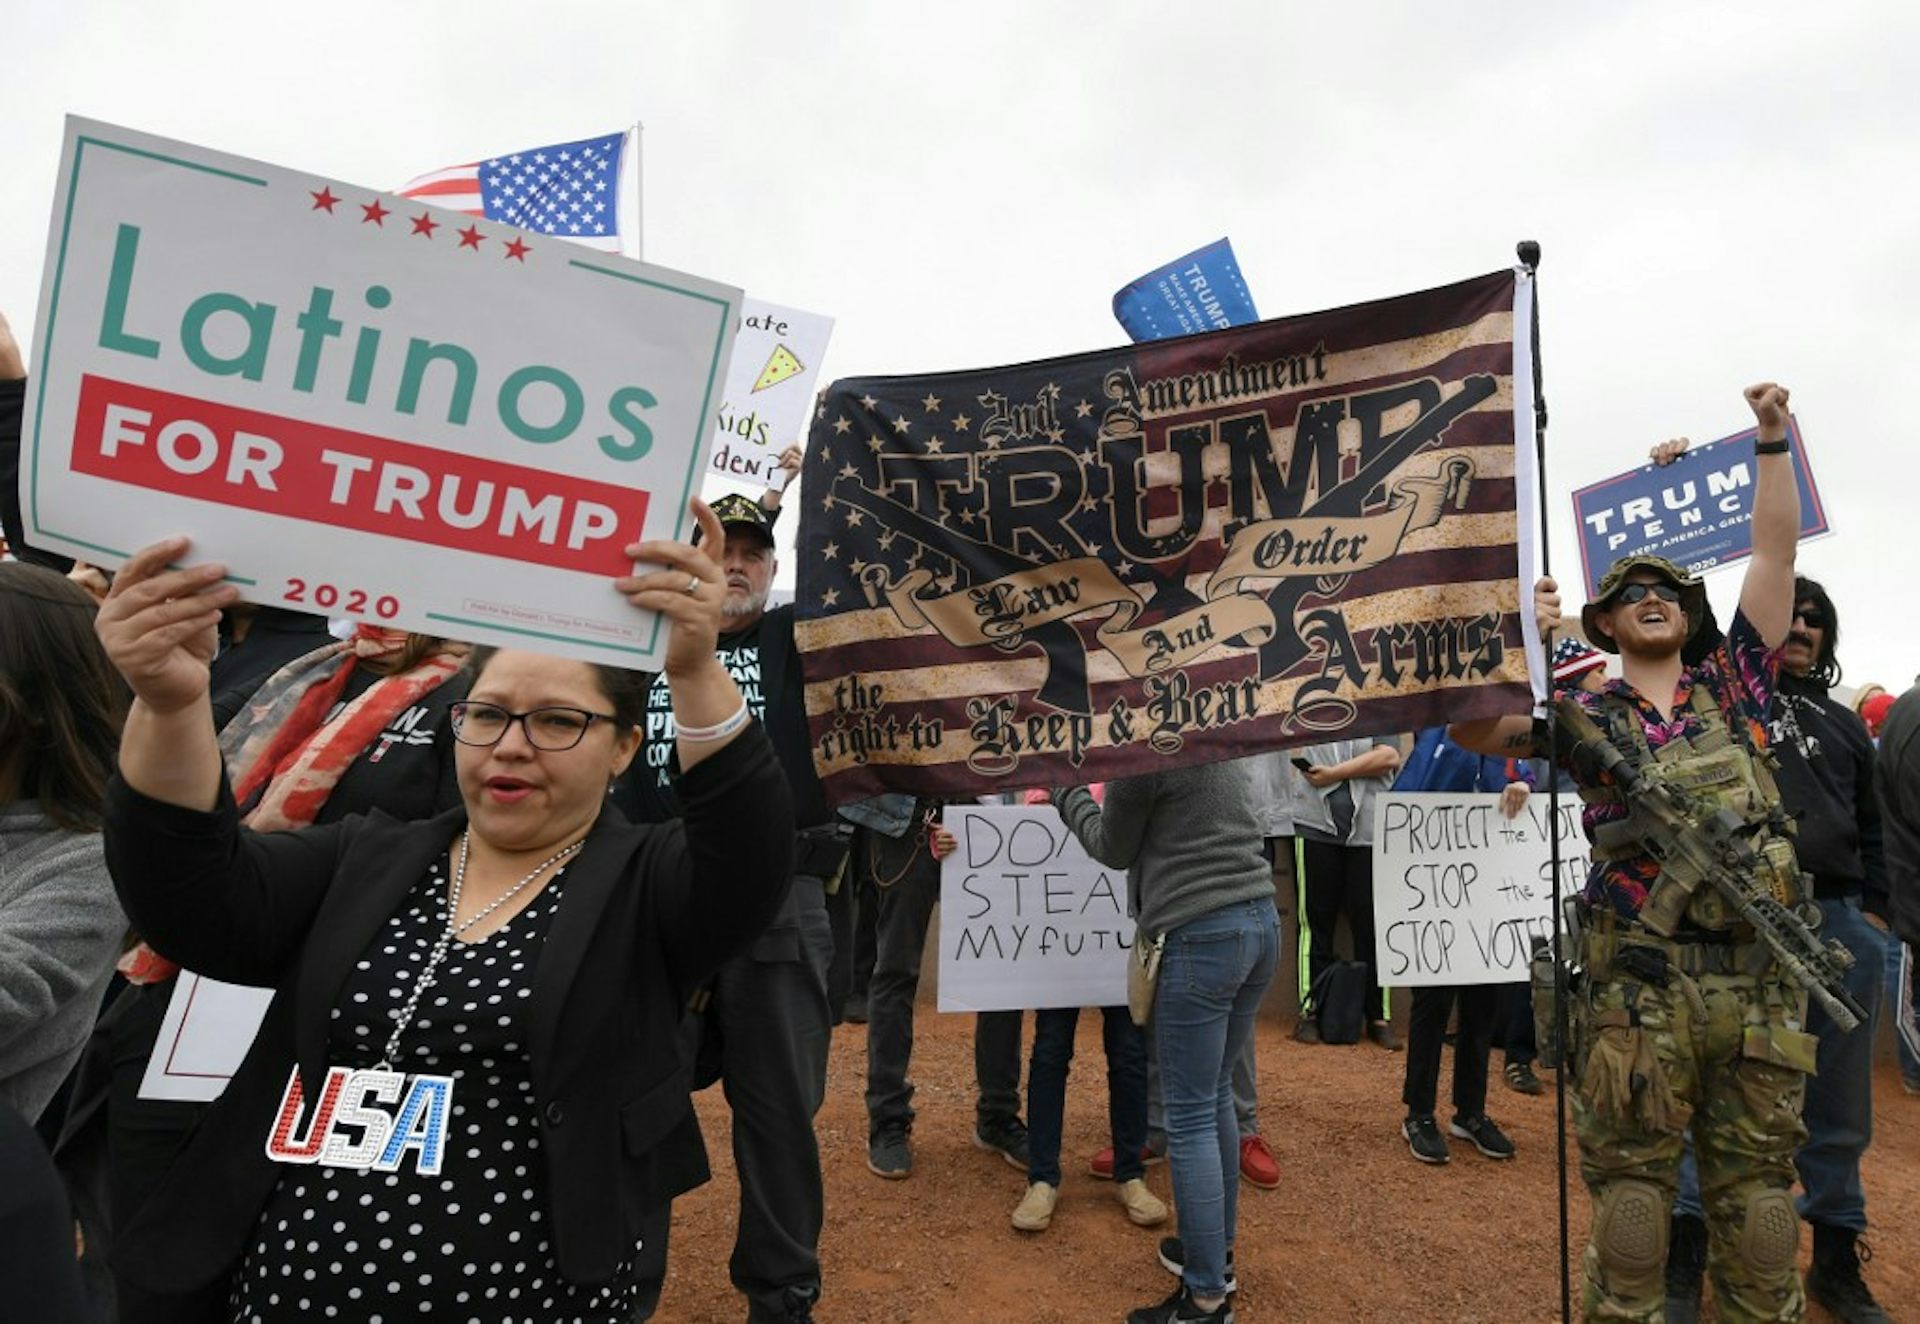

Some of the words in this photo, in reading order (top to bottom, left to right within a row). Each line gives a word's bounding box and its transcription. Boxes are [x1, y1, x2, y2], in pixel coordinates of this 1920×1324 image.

[1158, 281, 1181, 311] GREAT
[1177, 313, 1195, 334] AGA
[1184, 263, 1232, 329] TRUMP
[1184, 299, 1208, 333] AMERIC
[98, 224, 657, 463] Latinos
[744, 315, 789, 337] ate
[977, 386, 1060, 443] 2nd
[1102, 341, 1329, 434] Amendment
[101, 403, 284, 490] FOR
[322, 450, 618, 550] TRUMP
[877, 376, 1442, 580] TRUMP
[1585, 462, 1751, 535] TRUM
[1608, 494, 1742, 551] PENC
[1662, 525, 1716, 548] AMERICA
[1719, 511, 1754, 529] GREA
[284, 579, 400, 619] 2020
[969, 575, 1080, 638] Law
[1143, 613, 1216, 671] And
[1252, 525, 1368, 570] Order
[819, 715, 899, 763] right
[909, 714, 943, 752] to
[966, 695, 1093, 774] Keep
[1107, 699, 1135, 746] &
[1143, 669, 1263, 753] Bear
[1280, 601, 1505, 735] Arms
[833, 674, 882, 714] the
[1384, 803, 1493, 854] PROTECT
[1500, 818, 1528, 843] the
[1528, 803, 1585, 843] VOT
[962, 872, 1134, 919] STEA
[1404, 862, 1478, 911] STOP
[1497, 876, 1534, 903] the
[956, 925, 1029, 961] MY
[1386, 919, 1456, 976] STOP
[266, 1062, 455, 1176] USA
